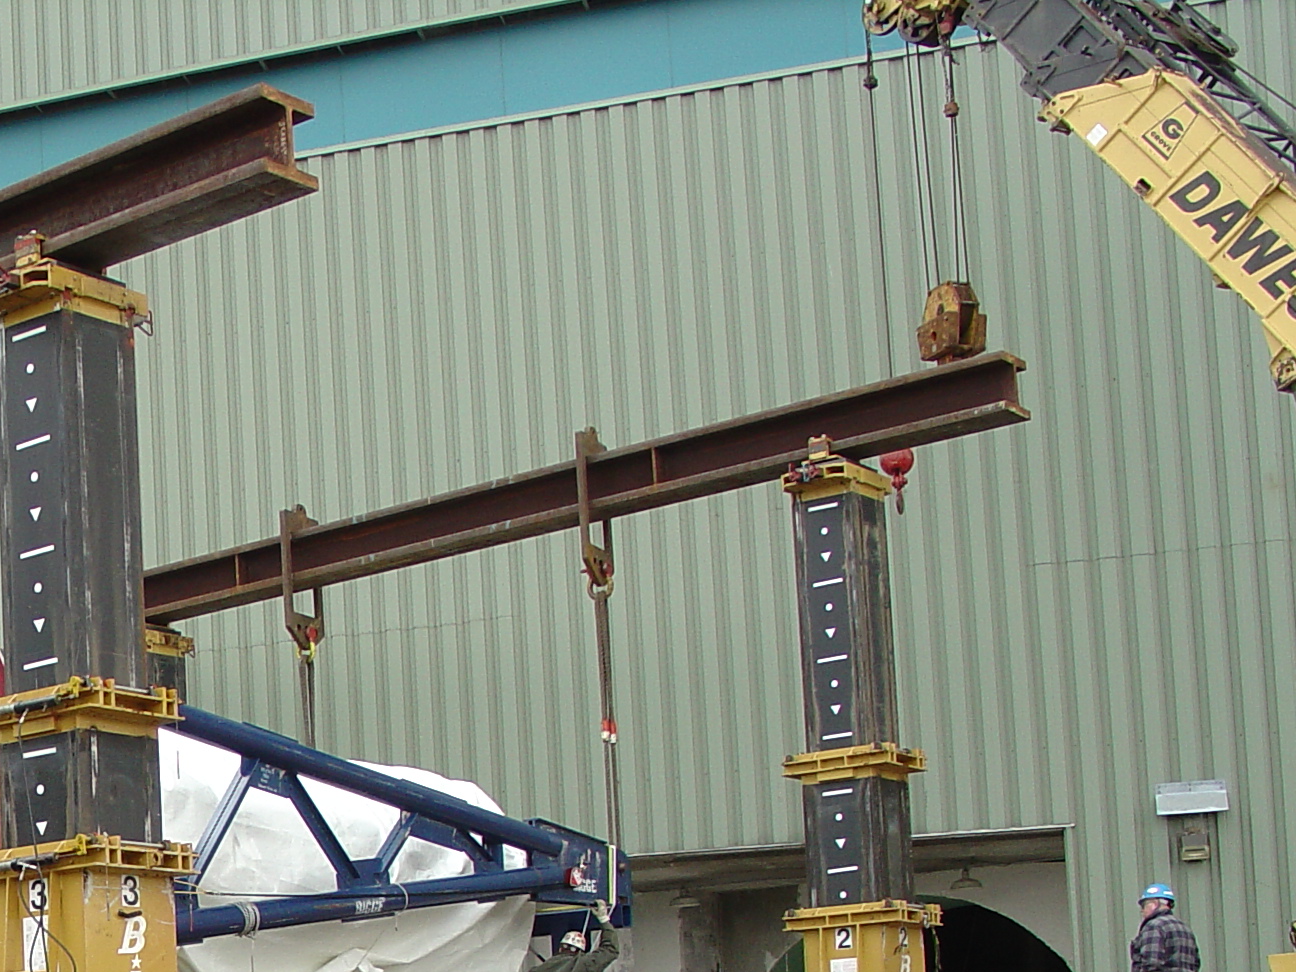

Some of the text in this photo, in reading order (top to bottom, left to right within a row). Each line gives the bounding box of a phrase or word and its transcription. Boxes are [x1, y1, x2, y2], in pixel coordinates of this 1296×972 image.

[1149, 130, 1172, 152] GROVE
[1168, 170, 1296, 321] DAWE
[30, 879, 47, 910] 3
[122, 875, 140, 907] 3
[837, 927, 852, 949] 2
[900, 927, 909, 948] 2
